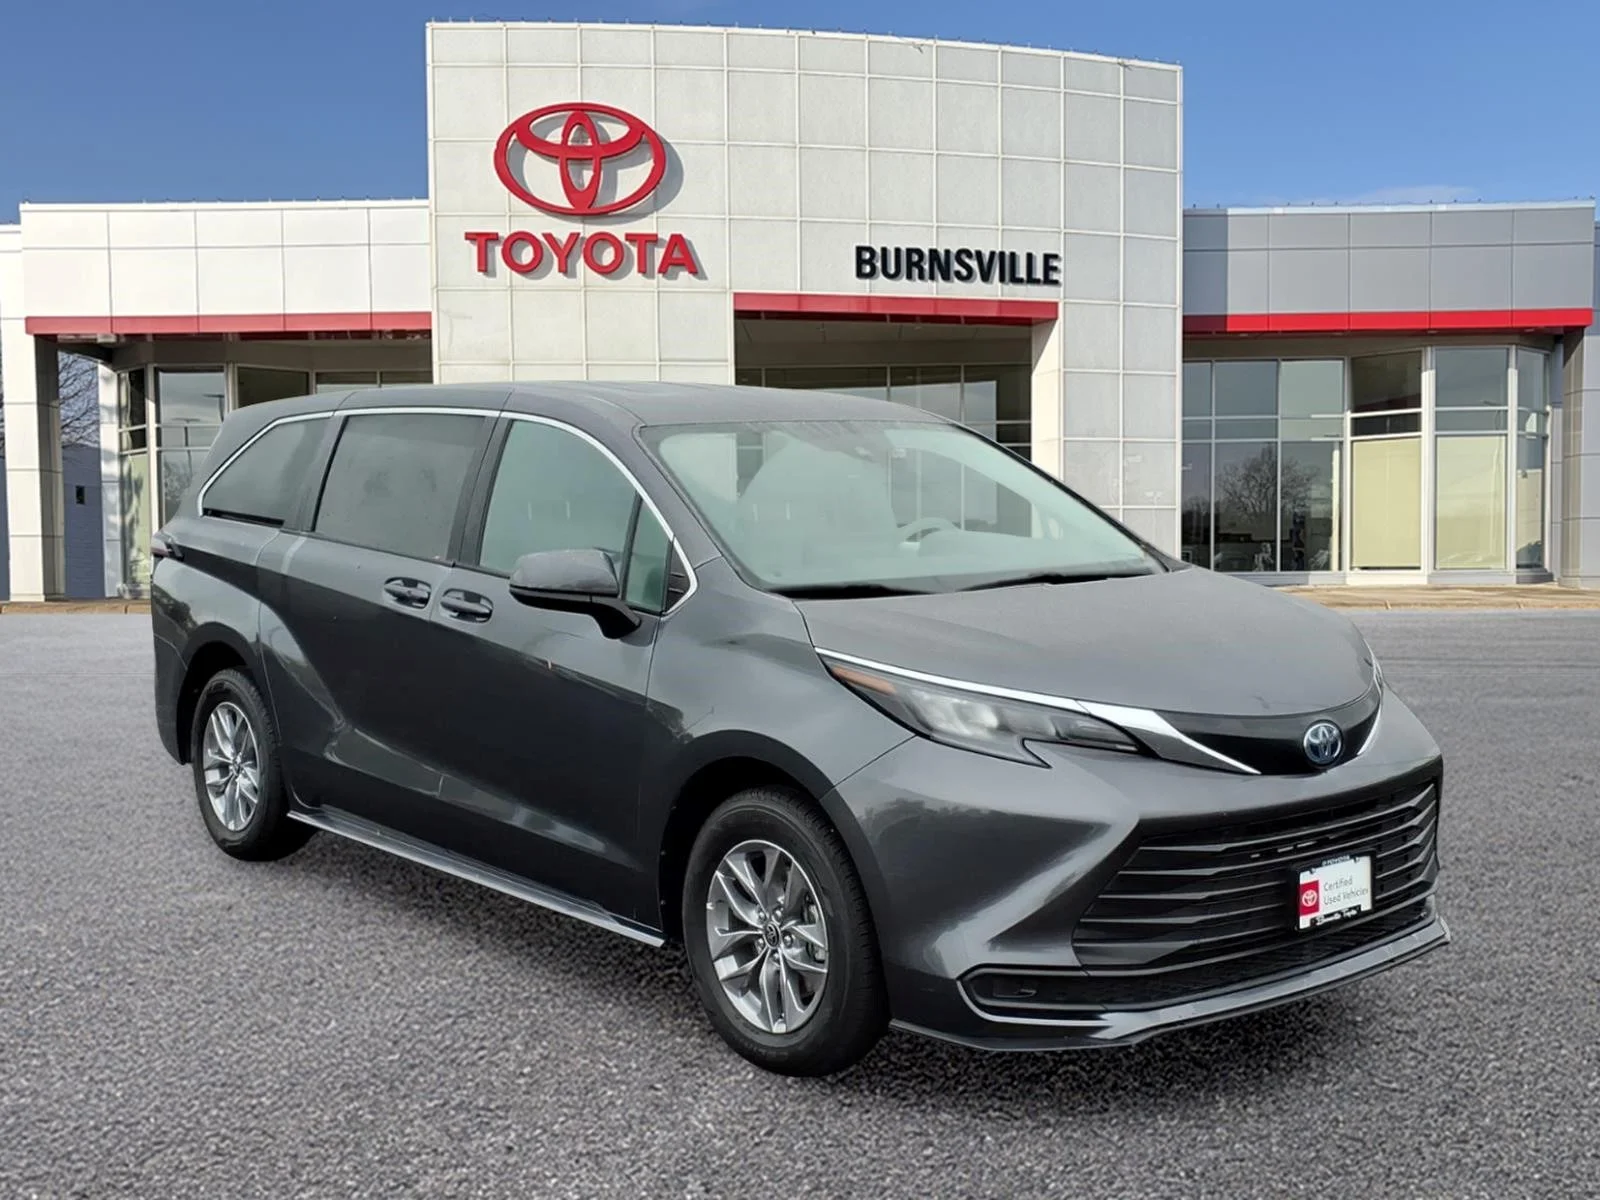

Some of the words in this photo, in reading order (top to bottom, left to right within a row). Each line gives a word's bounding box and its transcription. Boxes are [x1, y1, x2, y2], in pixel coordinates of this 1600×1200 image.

[464, 231, 699, 275] TOYOTA
[855, 245, 1061, 286] BURNSVILLE
[1323, 875, 1353, 892] Certified
[1323, 894, 1341, 906] Used
